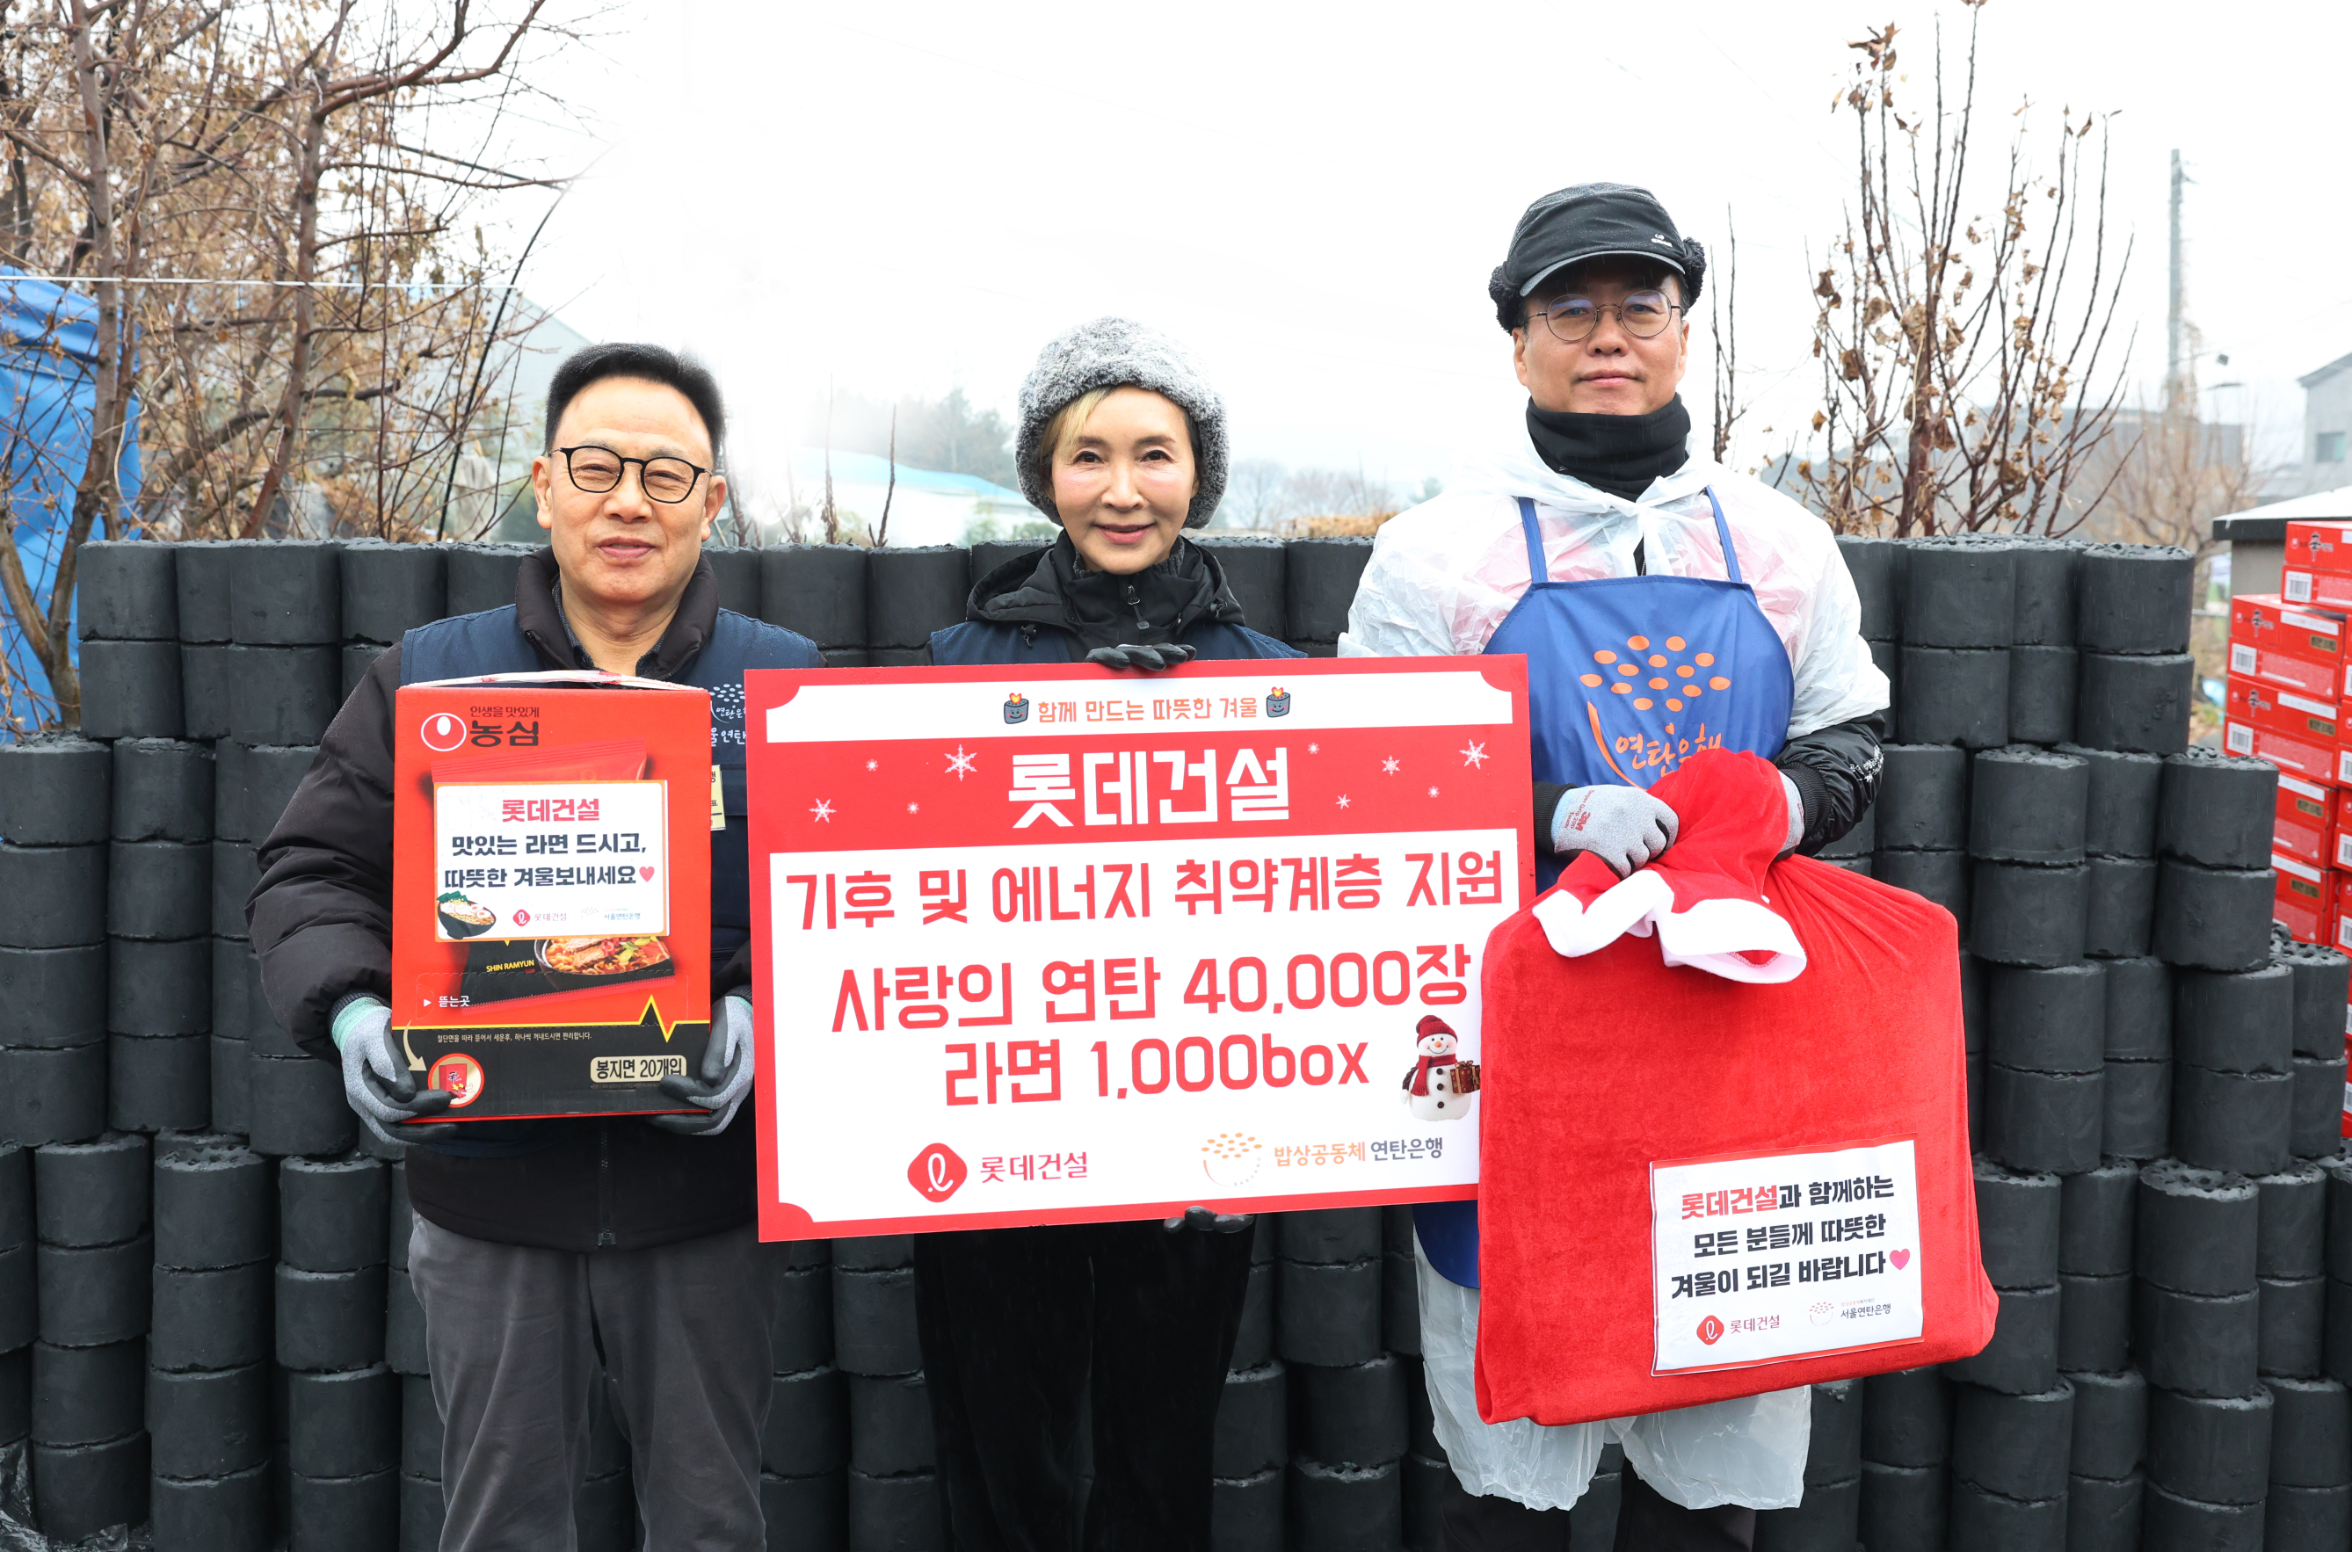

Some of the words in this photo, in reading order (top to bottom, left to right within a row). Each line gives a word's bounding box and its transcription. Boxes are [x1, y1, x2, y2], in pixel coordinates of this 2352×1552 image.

[470, 706, 503, 717] 인생을
[506, 707, 539, 717] 맛있게
[716, 707, 746, 719] 연탄은
[1038, 702, 1076, 723] 함께
[1086, 700, 1144, 721] 만드는
[1153, 698, 1211, 720] 따뜻한
[1219, 698, 1257, 718] 겨울
[470, 720, 538, 747] 농심
[1009, 747, 1289, 828] 롯데건설
[502, 799, 599, 822] 롯데건설
[452, 836, 517, 856] 맛있는
[526, 834, 568, 854] 라면
[577, 833, 646, 853] 드시고,
[445, 868, 507, 888] 따뜻한
[514, 866, 636, 886] 겨울보내세요
[786, 870, 894, 930] 기후
[919, 869, 967, 925] 및
[992, 863, 1150, 922] 에너지
[1175, 853, 1382, 915] 취약계층
[1405, 850, 1502, 906] 지원
[535, 913, 566, 921] 롯데건설
[486, 964, 503, 972] SHIN
[504, 960, 534, 970] RAMYUN
[832, 963, 1012, 1032] 사랑의
[1042, 957, 1161, 1023] 연탄
[1184, 944, 1471, 1016] 40,000장
[438, 995, 470, 1007] 뜯는곳
[462, 1034, 473, 1042] 따라
[515, 1033, 531, 1041] 하나씩
[596, 1059, 635, 1079] 봉지면
[945, 1039, 1061, 1106] 라면
[1091, 1033, 1369, 1099] 1,000box
[1275, 1142, 1365, 1166] 밥상공동체
[1371, 1137, 1442, 1161] 연탄은행
[981, 1152, 1087, 1183] 롯데건설
[1682, 1184, 1801, 1219] 롯데건설과
[1809, 1175, 1894, 1206] 함께하는
[1694, 1230, 1738, 1258] 모든
[1747, 1222, 1813, 1252] 분들께
[1821, 1214, 1886, 1242] 따뜻한
[1672, 1269, 1738, 1299] 겨울이
[1747, 1262, 1790, 1290] 되길
[1799, 1251, 1886, 1282] 바랍니다
[1840, 1303, 1892, 1319] 서울연탄은행
[1731, 1315, 1779, 1334] 롯데건설
